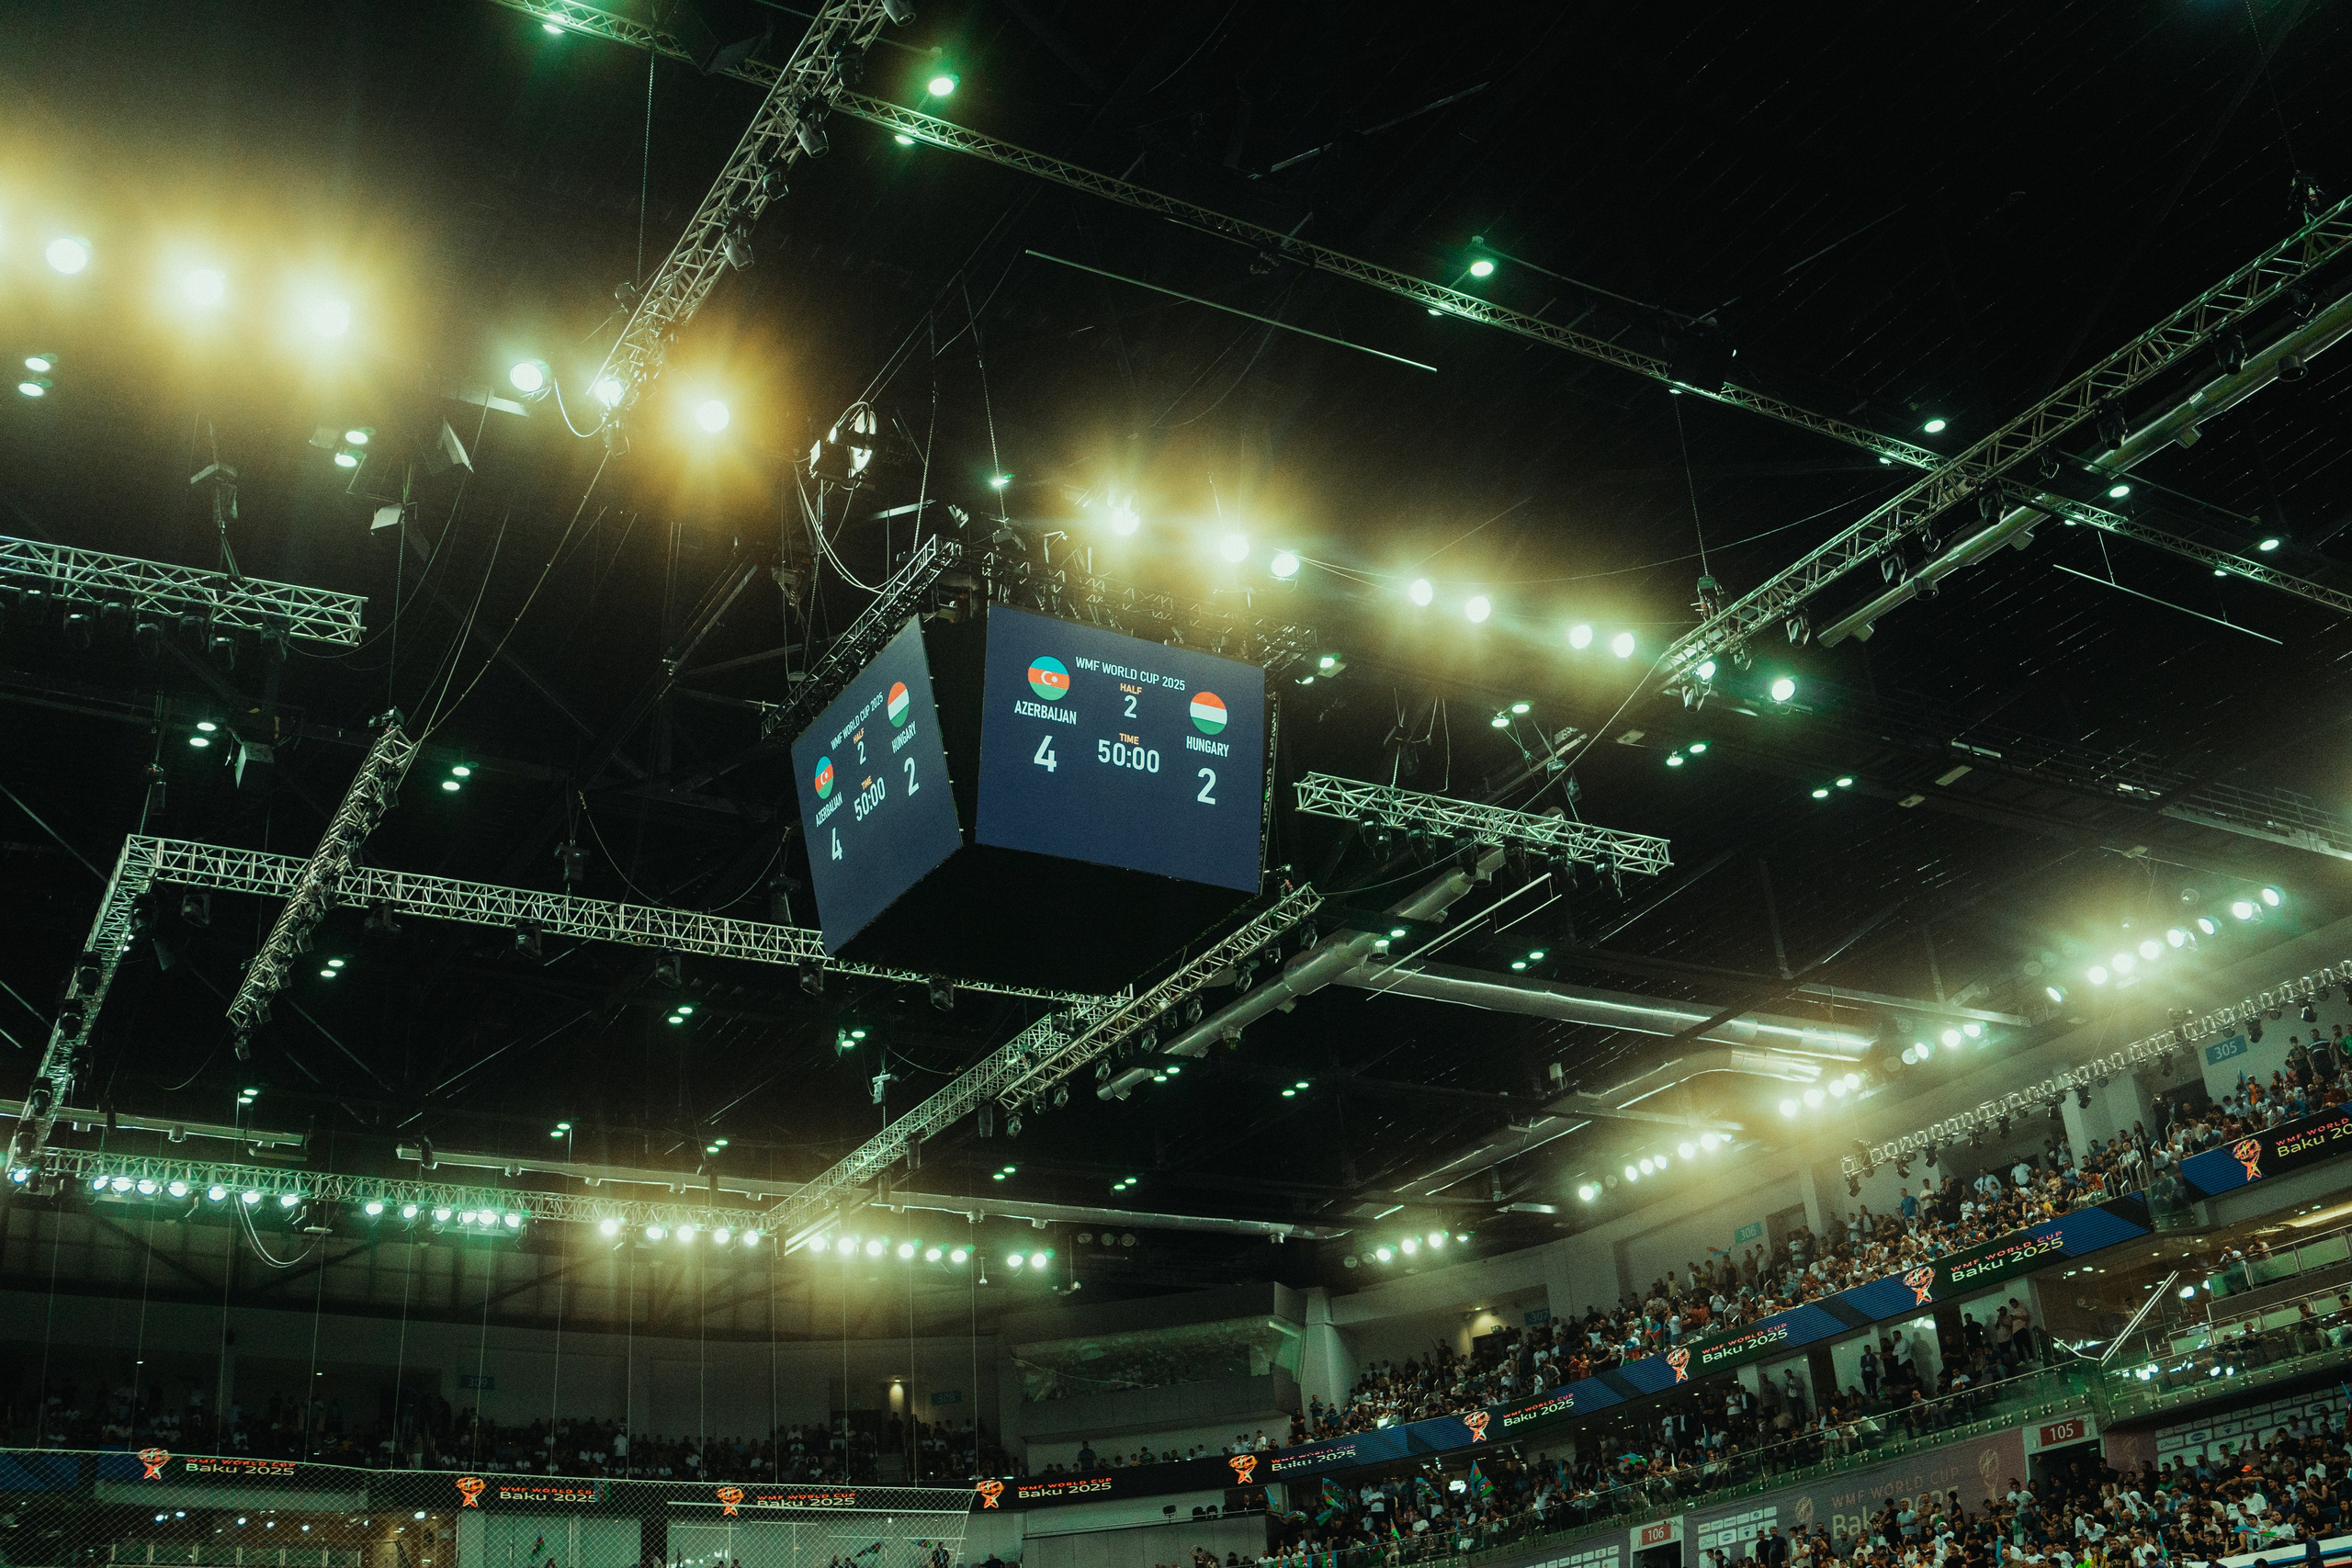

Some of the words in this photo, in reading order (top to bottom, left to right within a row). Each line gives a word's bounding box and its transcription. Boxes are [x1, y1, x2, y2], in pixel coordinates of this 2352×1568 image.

[1076, 656, 1100, 671] WMF
[1102, 662, 1136, 680] WORLD
[1139, 671, 1159, 684] CUP
[1162, 676, 1185, 691] 2025
[1120, 682, 1142, 694] HALF
[1014, 700, 1077, 726] AZERBAIJAN
[1124, 694, 1137, 718] 2
[831, 732, 842, 750] WMF
[842, 716, 861, 739] WORLD
[859, 705, 870, 724] CUP
[870, 691, 884, 712] 2025
[853, 728, 865, 744] HALF
[891, 720, 917, 753] HUNGARY
[1119, 732, 1139, 745] TIME
[1186, 735, 1229, 758] HUNGARY
[857, 740, 866, 765] 2
[1034, 735, 1057, 773] 4
[1098, 739, 1159, 773] 50:00
[861, 775, 872, 790] TIME
[903, 757, 920, 796] 2
[1197, 767, 1216, 806] 2
[816, 791, 842, 828] AZERBAIJAN
[854, 776, 886, 821] 50:00
[831, 827, 842, 861] 4
[2215, 1041, 2237, 1059] 305
[2276, 1133, 2302, 1146] WMF
[2306, 1118, 2349, 1136] WORLD
[2278, 1135, 2325, 1157] Baku
[1951, 1258, 1980, 1272] WMF
[1984, 1241, 2031, 1260] WORLD
[2037, 1230, 2063, 1243] CUP
[1951, 1258, 2004, 1282] Baku
[2010, 1237, 2064, 1263] 2025
[1702, 1343, 1724, 1355] WMF
[1728, 1331, 1764, 1346] WORLD
[1767, 1323, 1787, 1333] CUP
[1702, 1345, 1743, 1364] Baku
[1747, 1328, 1789, 1349] 2025
[1503, 1409, 1521, 1418] WMF
[1524, 1399, 1555, 1412] WORLD
[1557, 1393, 1574, 1402] CUP
[1503, 1411, 1537, 1427] Baku
[1541, 1398, 1575, 1416] 2025
[2050, 1423, 2074, 1441] 105
[186, 1463, 237, 1473] Baku
[244, 1465, 295, 1475] 2025
[500, 1491, 547, 1501] Baku
[1018, 1487, 1062, 1498] Baku
[1069, 1483, 1112, 1495] 2025
[1047, 1480, 1087, 1488] WORLD
[1831, 1490, 1864, 1508] WMF
[1870, 1476, 1923, 1500] WORLD
[1930, 1467, 1960, 1484] CUP
[809, 1497, 855, 1506] 2025
[1648, 1526, 1665, 1541] 106
[1832, 1505, 1878, 1541] Bak
